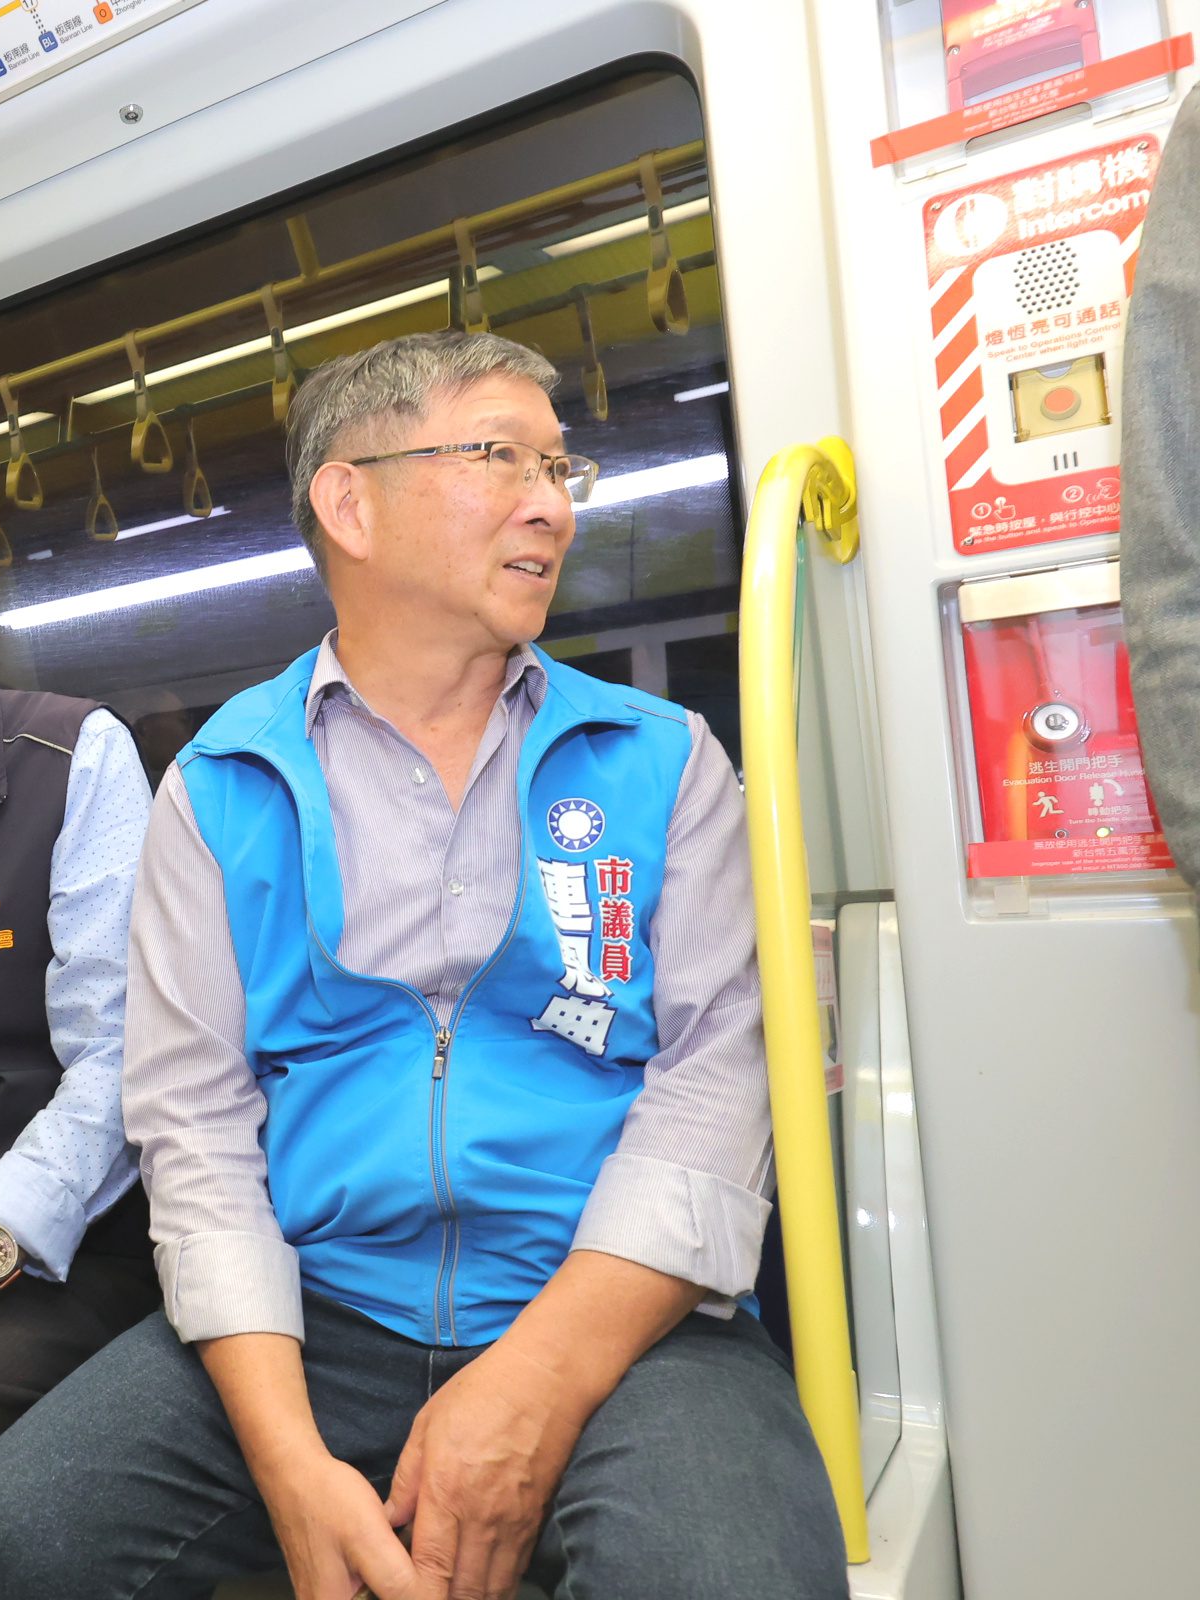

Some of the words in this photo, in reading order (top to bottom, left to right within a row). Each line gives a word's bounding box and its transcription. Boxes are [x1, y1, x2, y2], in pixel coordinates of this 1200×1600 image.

[54, 15, 83, 36] 板南線
[59, 29, 82, 44] Bannan
[81, 23, 94, 34] Line
[3, 42, 30, 63] 板南線
[8, 56, 29, 71] Bannan
[28, 51, 41, 64] Line
[1018, 188, 1151, 241] Intercom
[987, 346, 1017, 359] Speak
[1018, 342, 1029, 352] to
[1030, 331, 1083, 351] Operations
[1084, 321, 1122, 336] Control
[1005, 350, 1037, 363] Center
[1039, 342, 1065, 355] when
[1066, 336, 1089, 351] light
[1090, 334, 1105, 344] on
[1029, 753, 1123, 775] 逃生開門把手
[1002, 775, 1053, 787] Evacuation
[1054, 773, 1078, 783] Door
[1079, 770, 1118, 780] Release
[593, 855, 635, 985] 市議員
